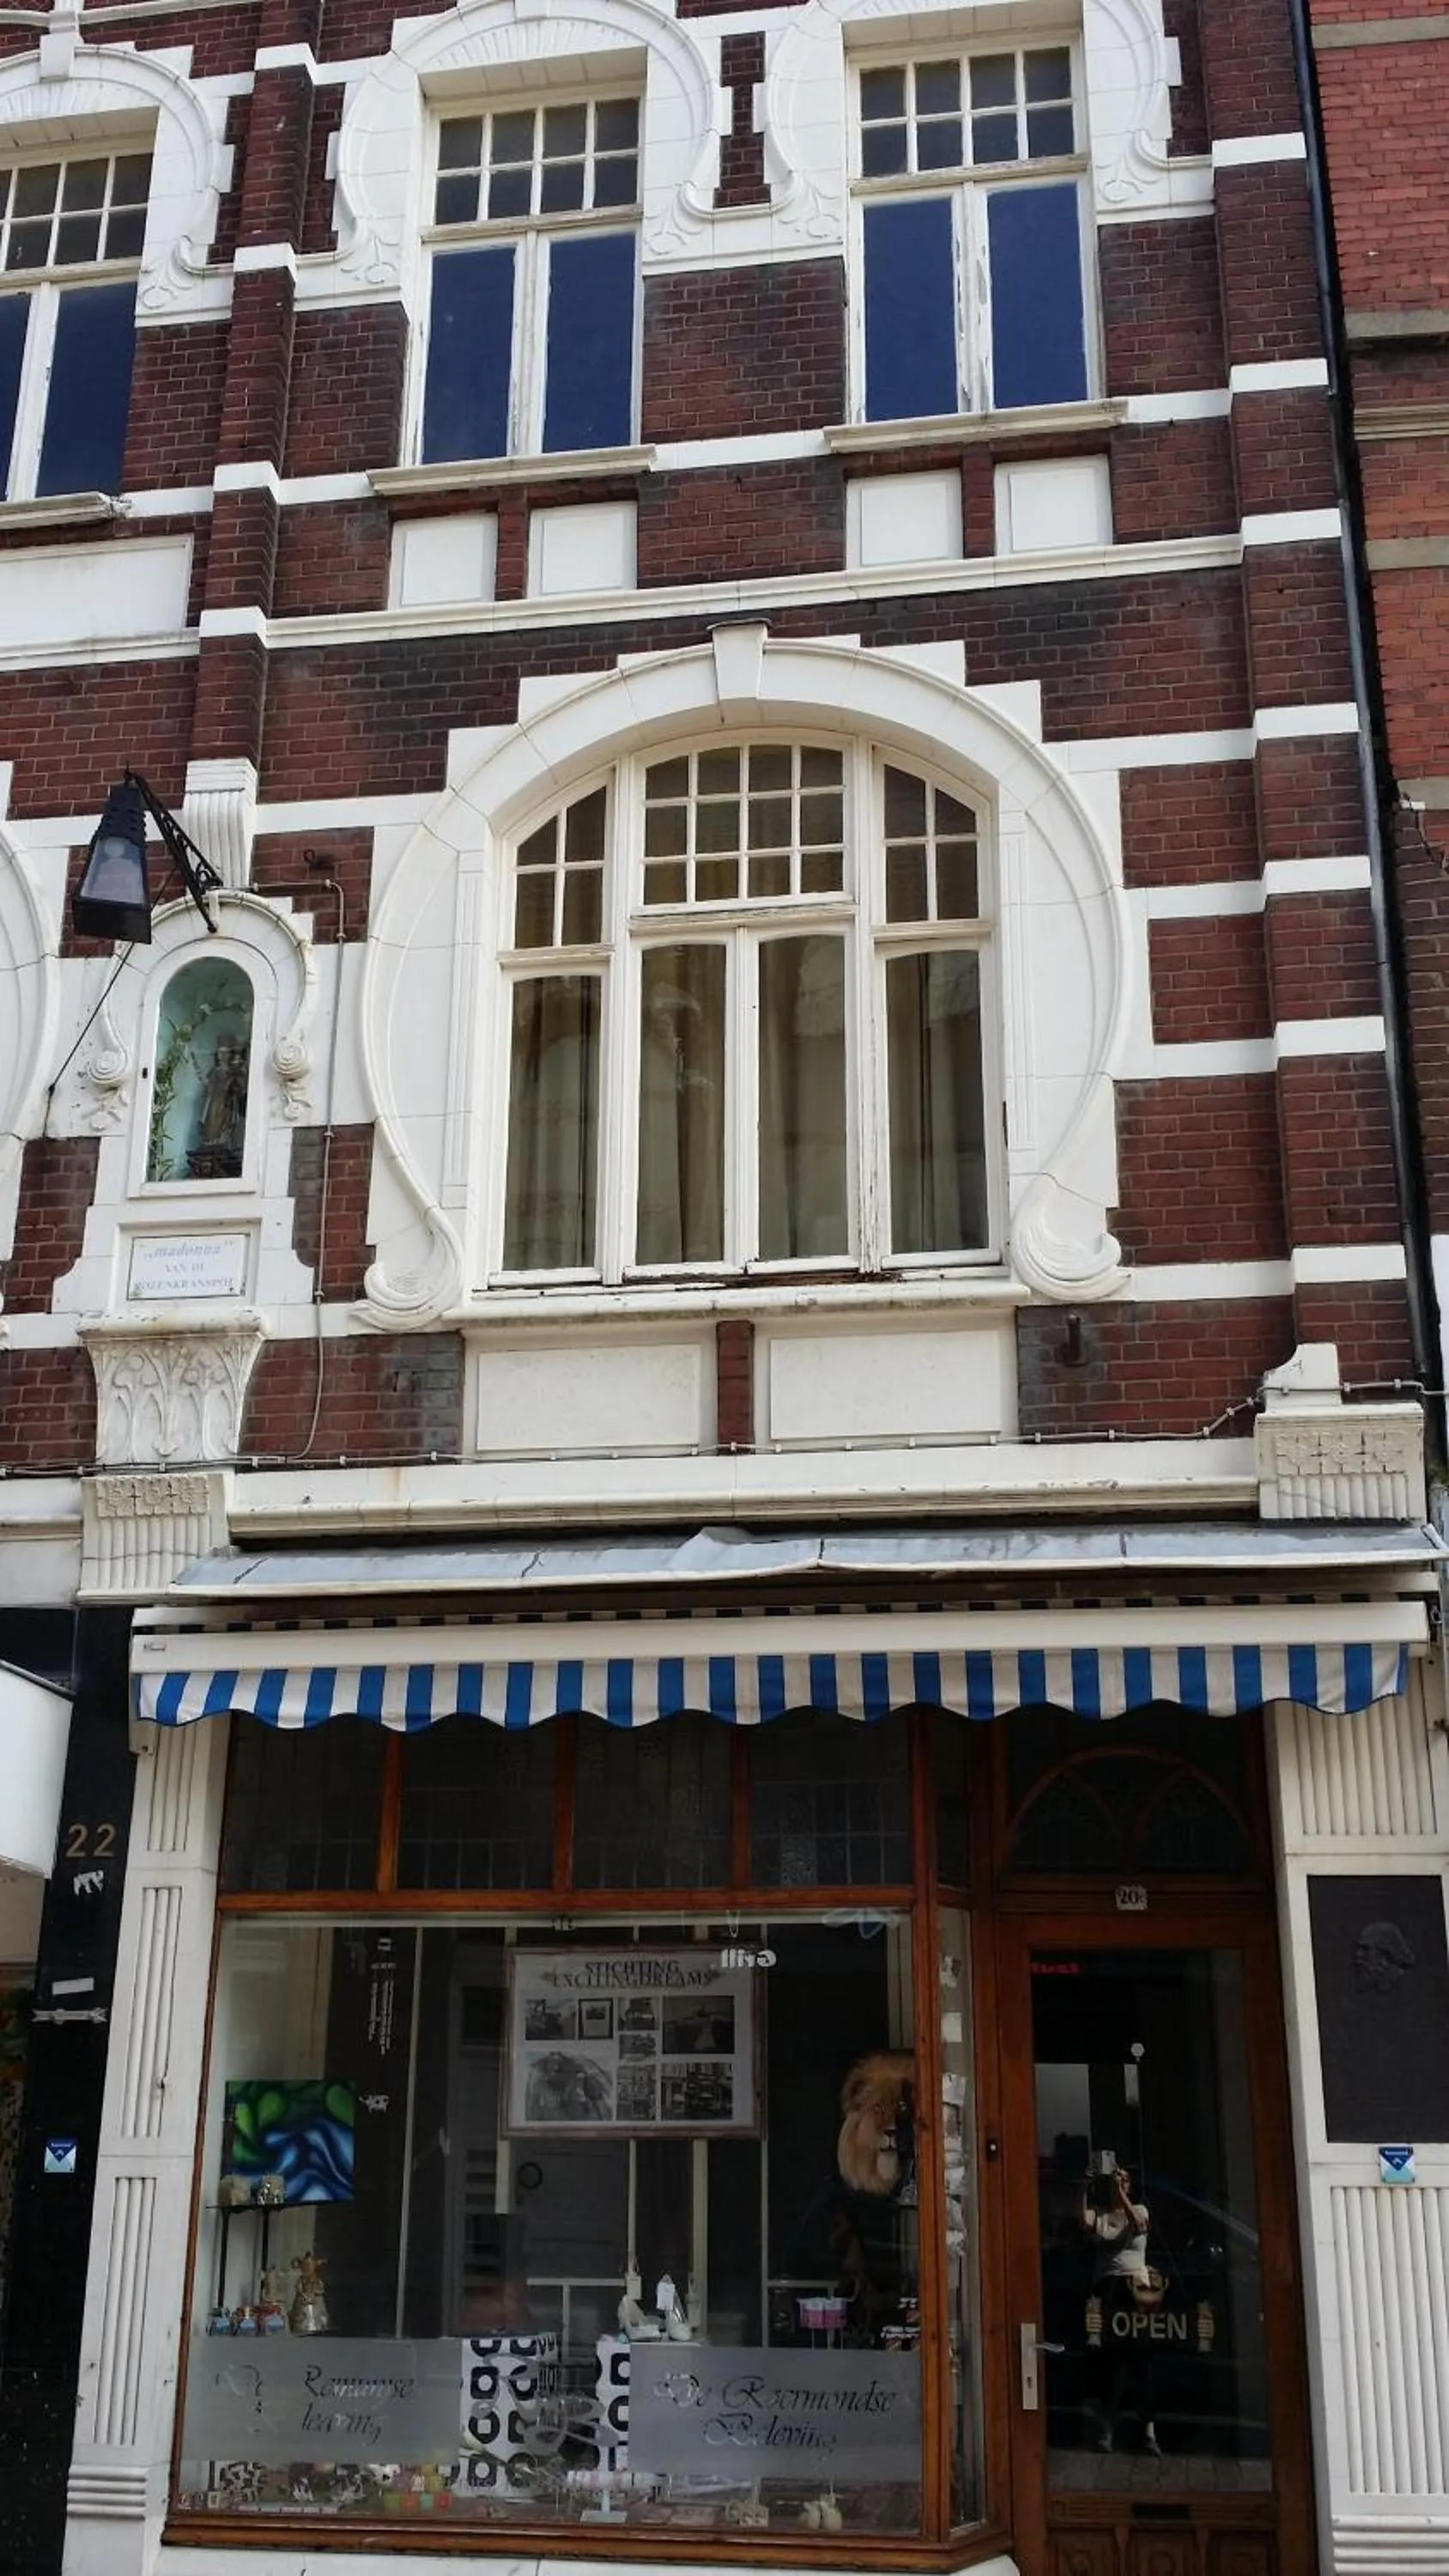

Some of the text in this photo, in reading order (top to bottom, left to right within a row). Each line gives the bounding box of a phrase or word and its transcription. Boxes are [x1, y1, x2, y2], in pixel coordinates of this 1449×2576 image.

[66, 1823, 116, 1856] 22
[585, 1960, 679, 1975] STICHTING
[1112, 2312, 1187, 2340] OPEN
